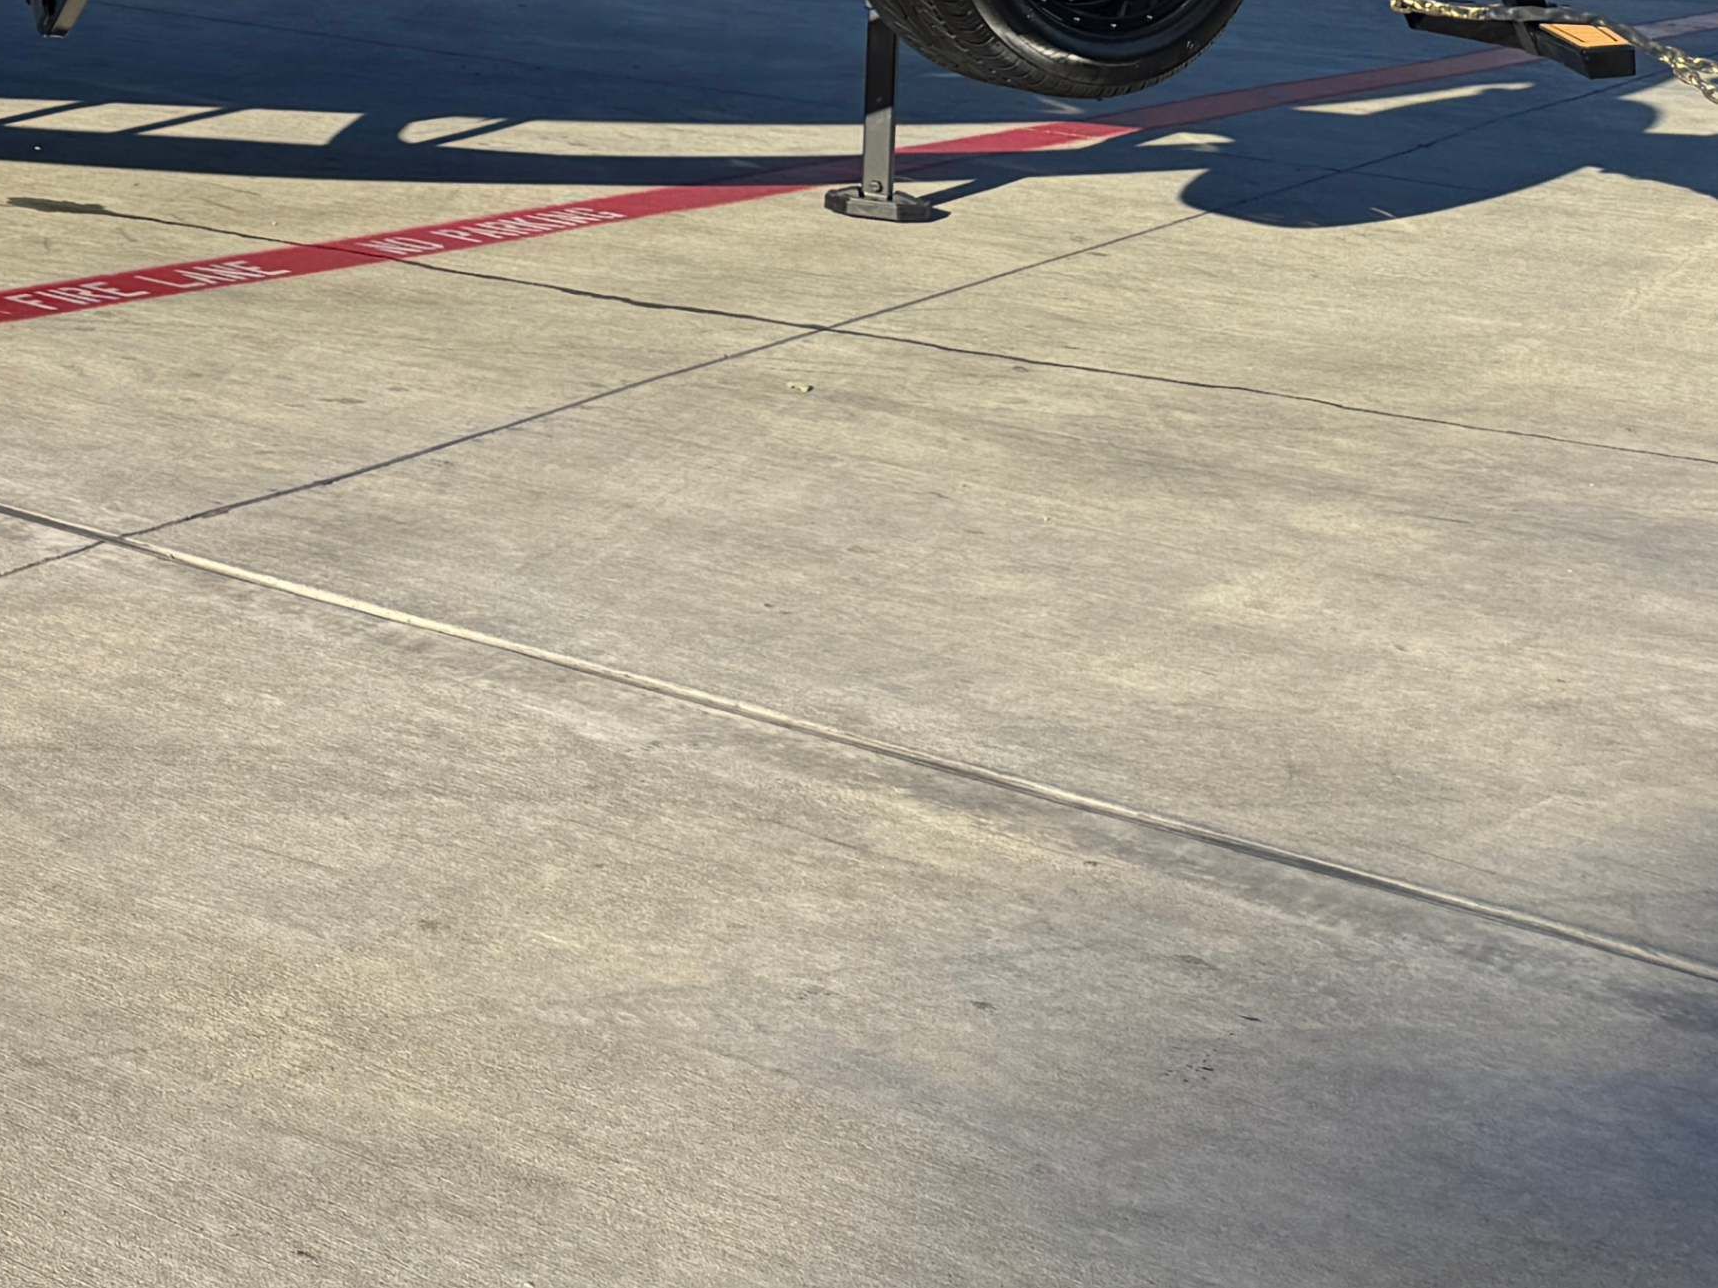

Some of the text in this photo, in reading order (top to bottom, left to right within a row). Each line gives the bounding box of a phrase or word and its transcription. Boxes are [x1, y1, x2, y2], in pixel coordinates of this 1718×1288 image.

[4, 207, 627, 310] FIRE LANE NO PARKING
